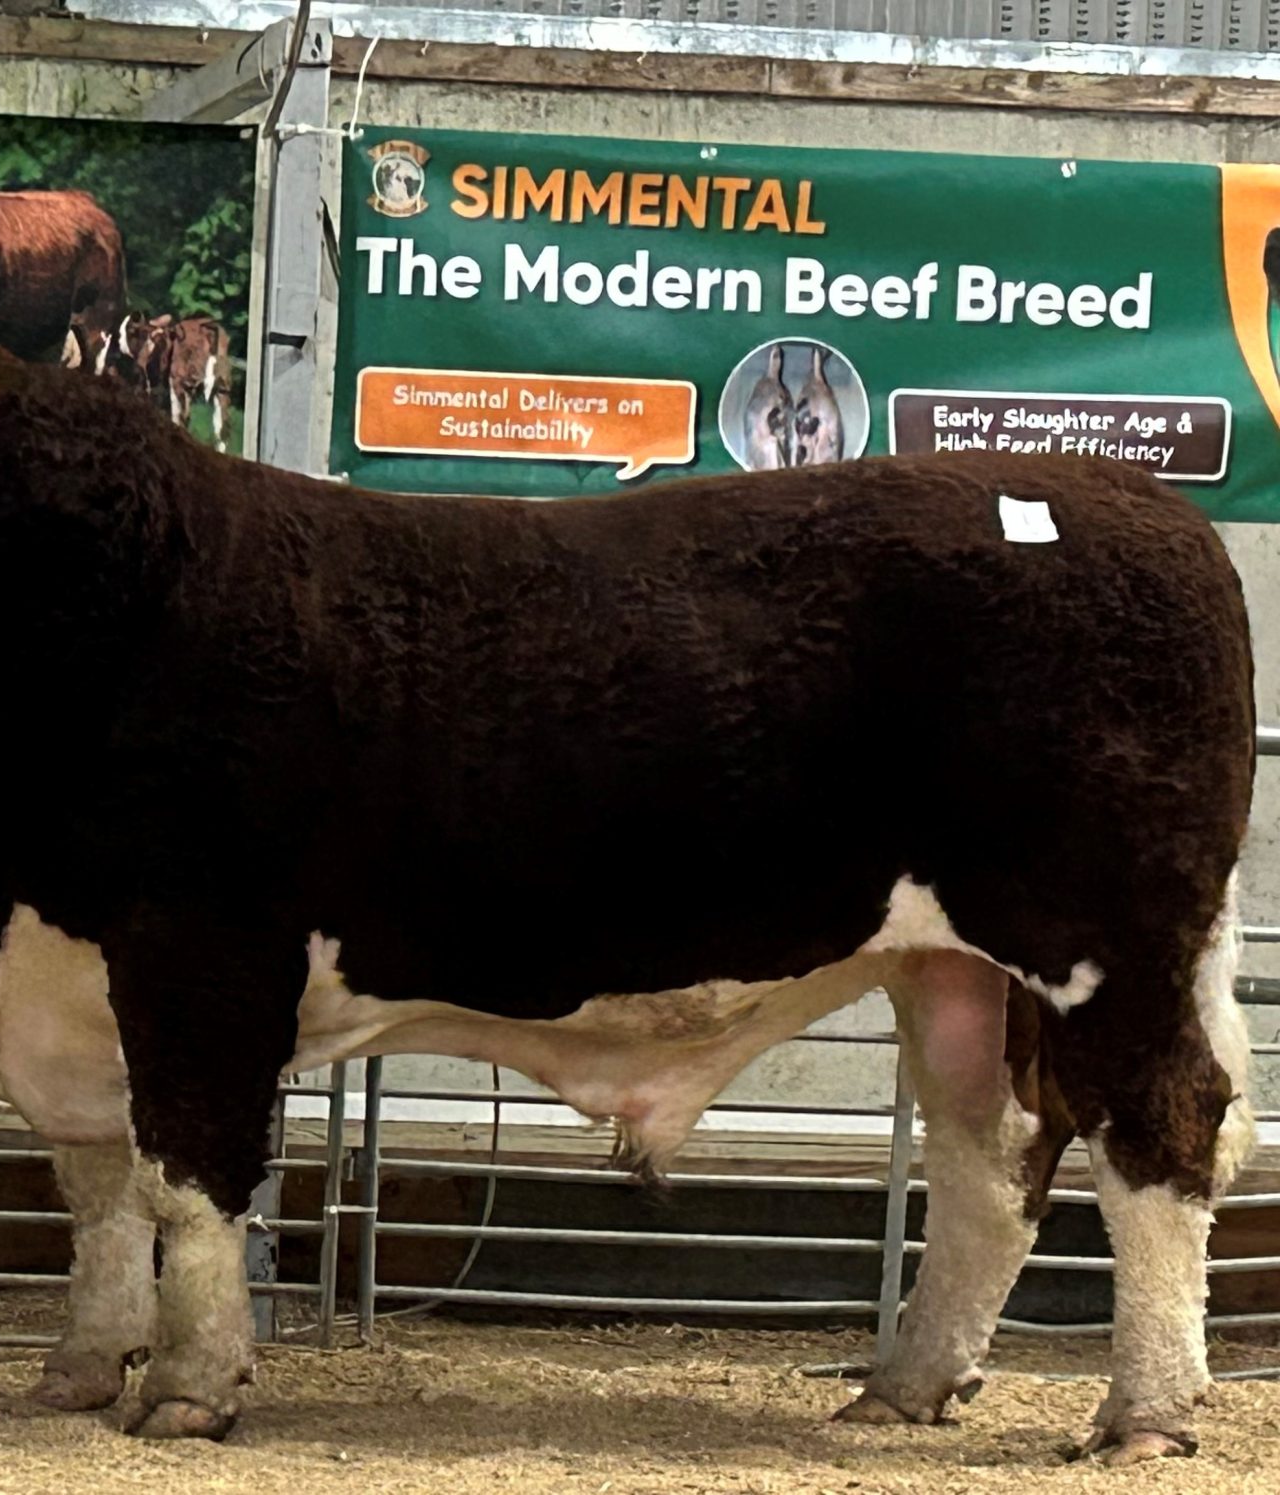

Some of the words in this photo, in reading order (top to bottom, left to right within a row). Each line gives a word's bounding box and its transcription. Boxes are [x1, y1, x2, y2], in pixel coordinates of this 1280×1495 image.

[450, 163, 826, 235] SIMMENTAL
[356, 236, 482, 299] The
[504, 243, 762, 313] Modern
[785, 257, 938, 320] Beef
[956, 264, 1153, 330] Breed
[392, 384, 509, 410] Simmental
[519, 388, 609, 415] Delivers
[618, 398, 644, 416] on
[439, 416, 594, 449] Sustainability
[933, 405, 995, 433] Early
[1002, 408, 1116, 435] Slaughter
[1124, 412, 1168, 438] Age
[1176, 411, 1193, 434] &
[1061, 436, 1175, 468] Efficiency
